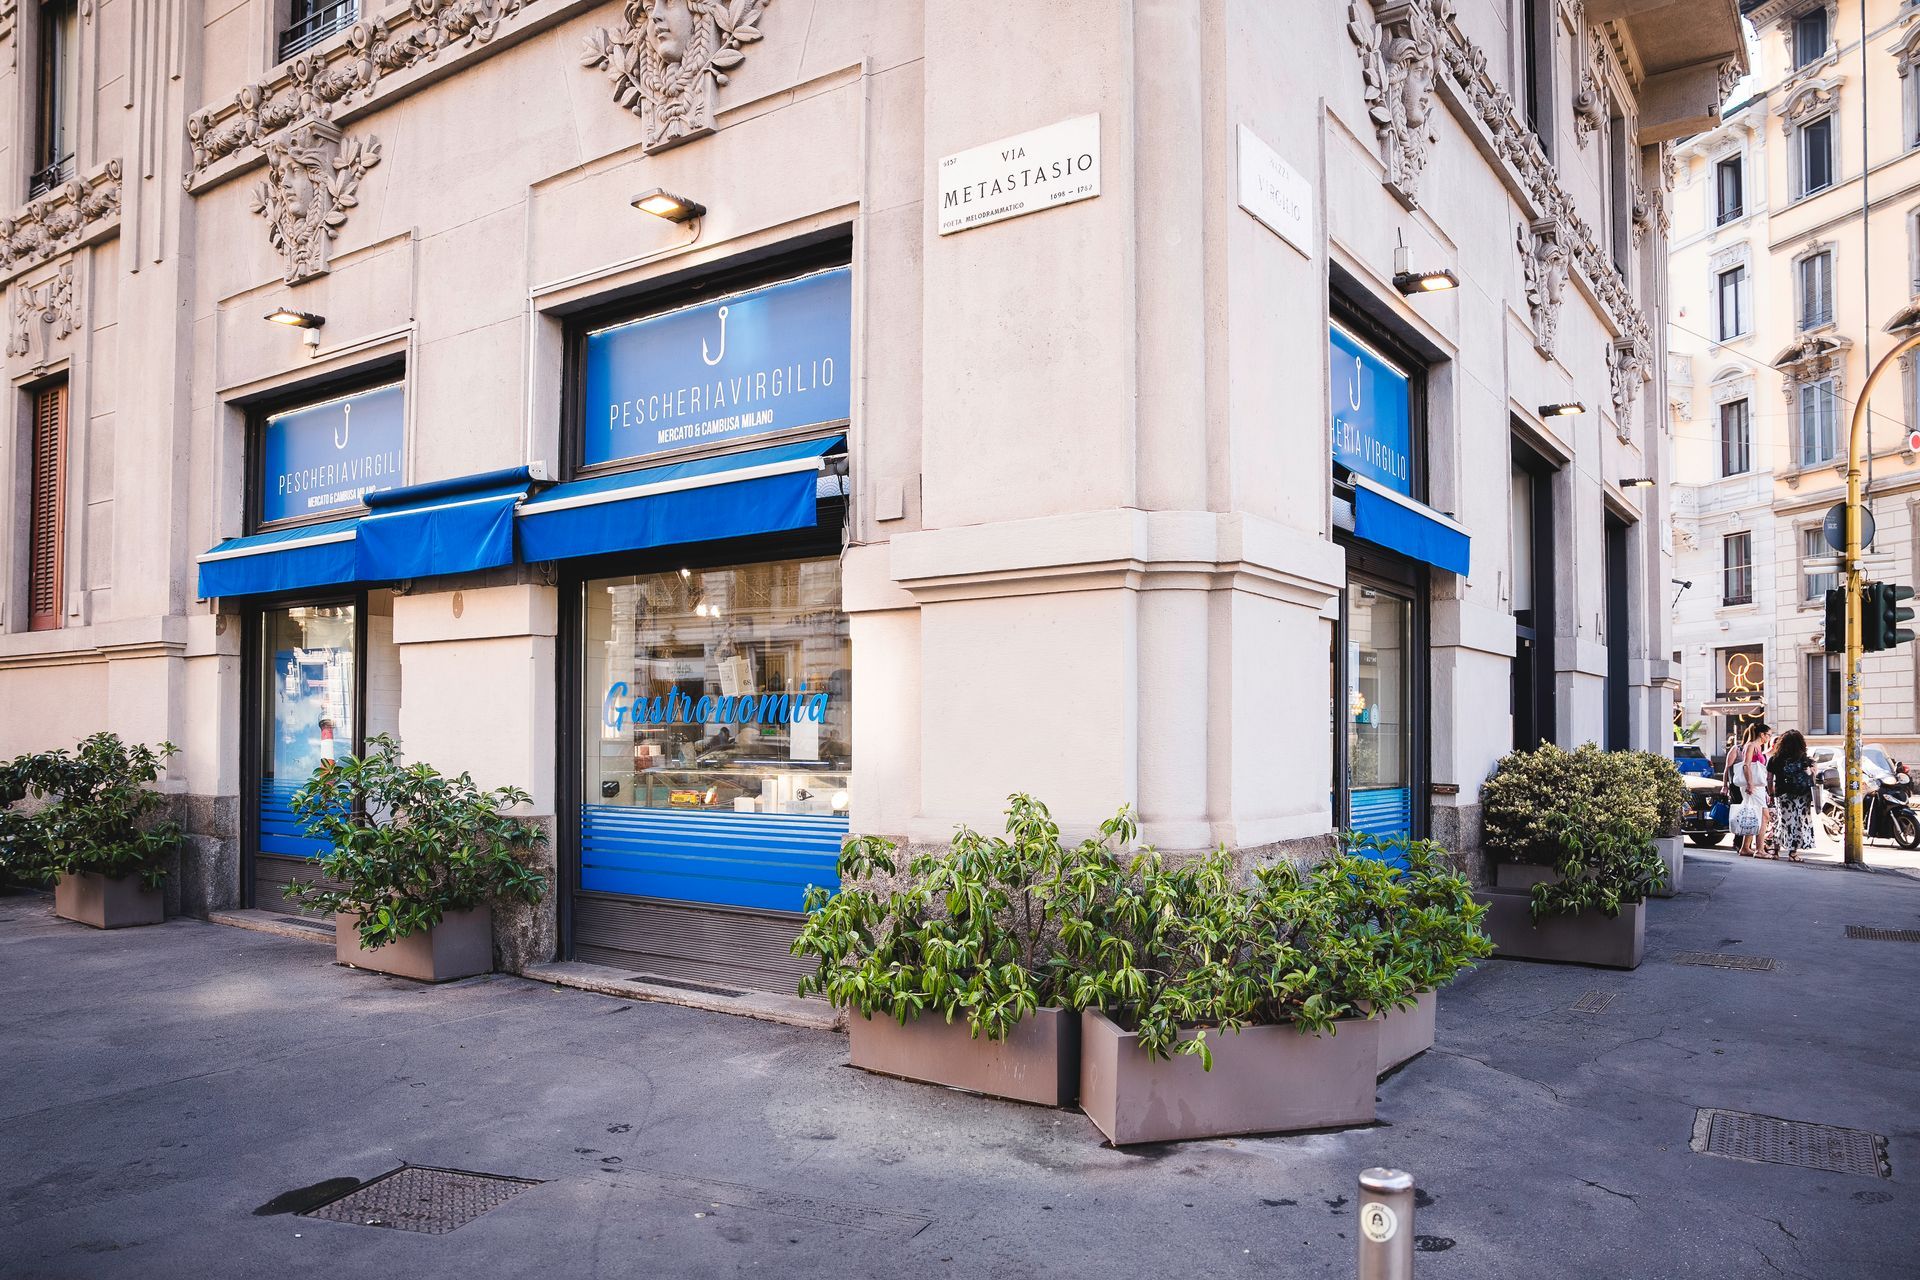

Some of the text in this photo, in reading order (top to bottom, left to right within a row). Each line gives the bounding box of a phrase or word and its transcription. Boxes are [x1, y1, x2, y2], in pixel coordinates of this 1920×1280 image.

[1001, 147, 1026, 162] VIA
[943, 153, 1093, 209] METASTASIO
[965, 201, 1025, 223] MELODRAMMATICO
[610, 357, 835, 431] PESCHERIAVIRGILIO
[657, 409, 774, 445] MERCATO & CAMBUSA MILANO
[307, 493, 330, 508] MERCATO
[333, 488, 357, 503] CAMBUSA
[603, 681, 830, 732] Gastronomia
